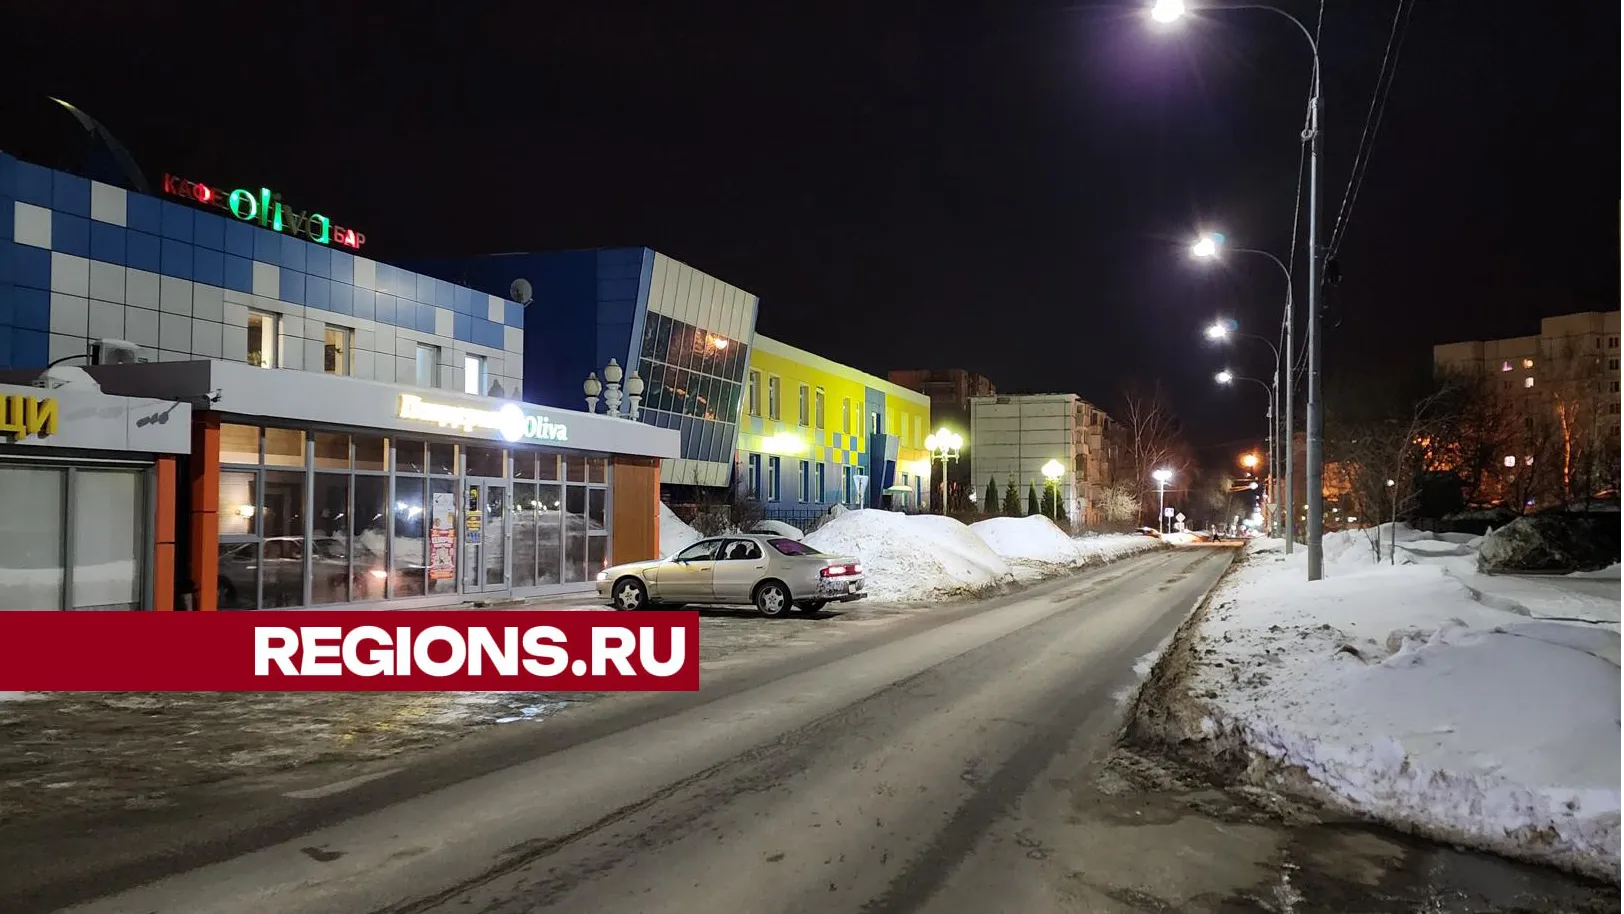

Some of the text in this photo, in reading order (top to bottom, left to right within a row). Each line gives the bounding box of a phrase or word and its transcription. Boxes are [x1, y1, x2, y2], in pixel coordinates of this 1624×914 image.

[164, 173, 224, 208] КАФЕ
[333, 225, 366, 249] БАР
[523, 415, 568, 442] Oliva
